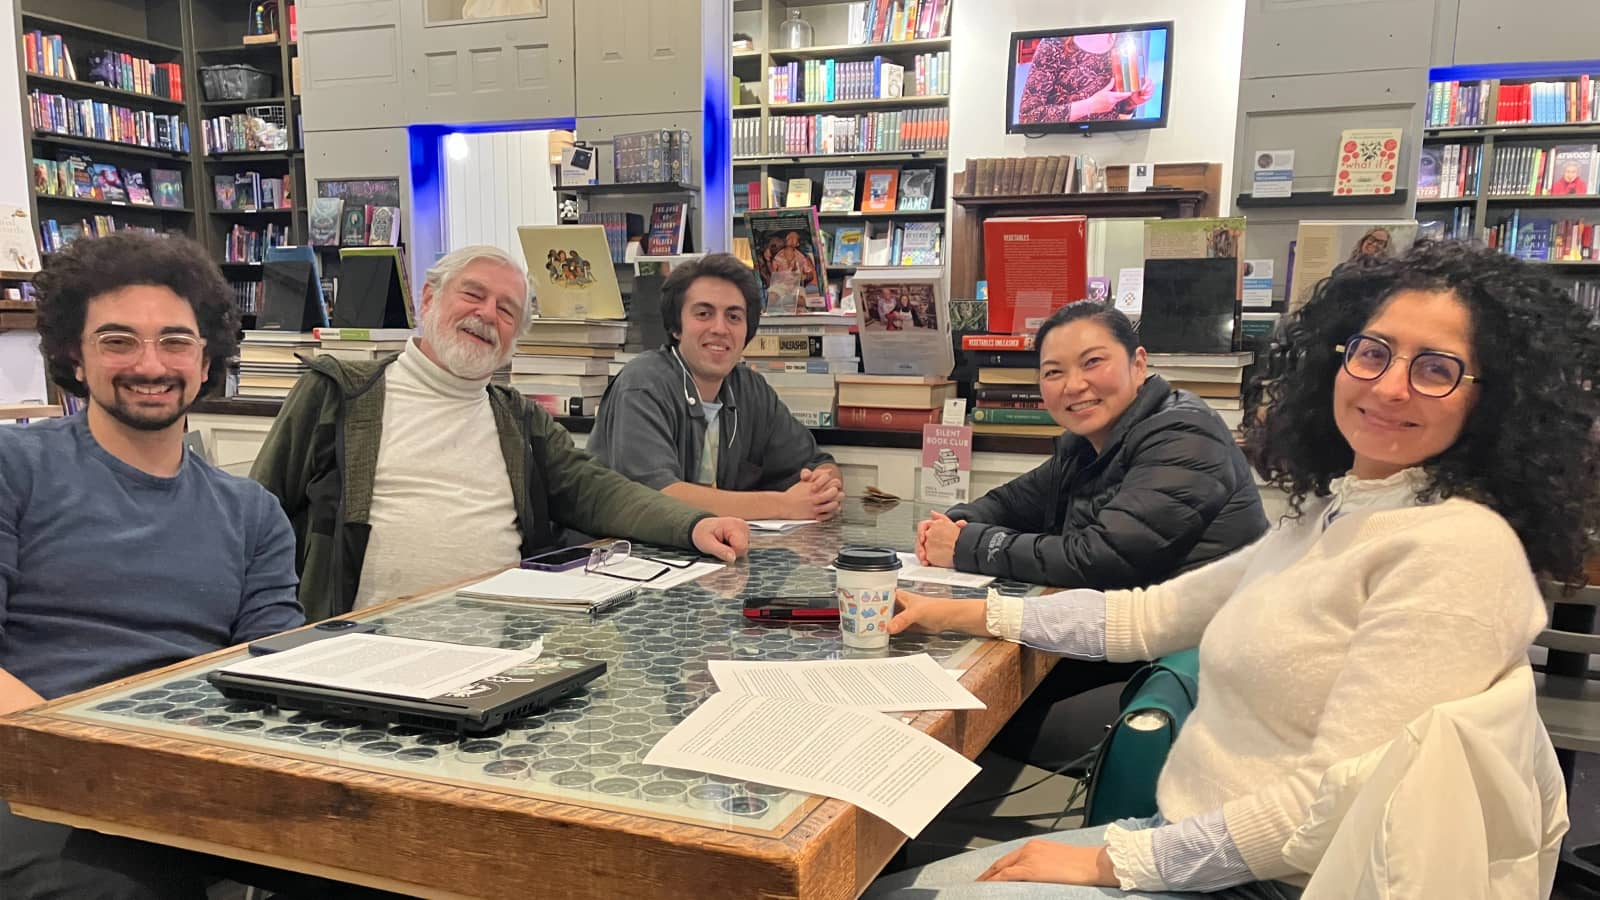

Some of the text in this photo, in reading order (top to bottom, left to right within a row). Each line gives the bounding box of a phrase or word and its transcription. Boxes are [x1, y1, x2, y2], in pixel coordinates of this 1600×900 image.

[1557, 151, 1591, 160] ATWOOD
[899, 197, 929, 209] DAMS
[935, 428, 961, 437] SILENT
[926, 436, 969, 448] BOOK CLUB
